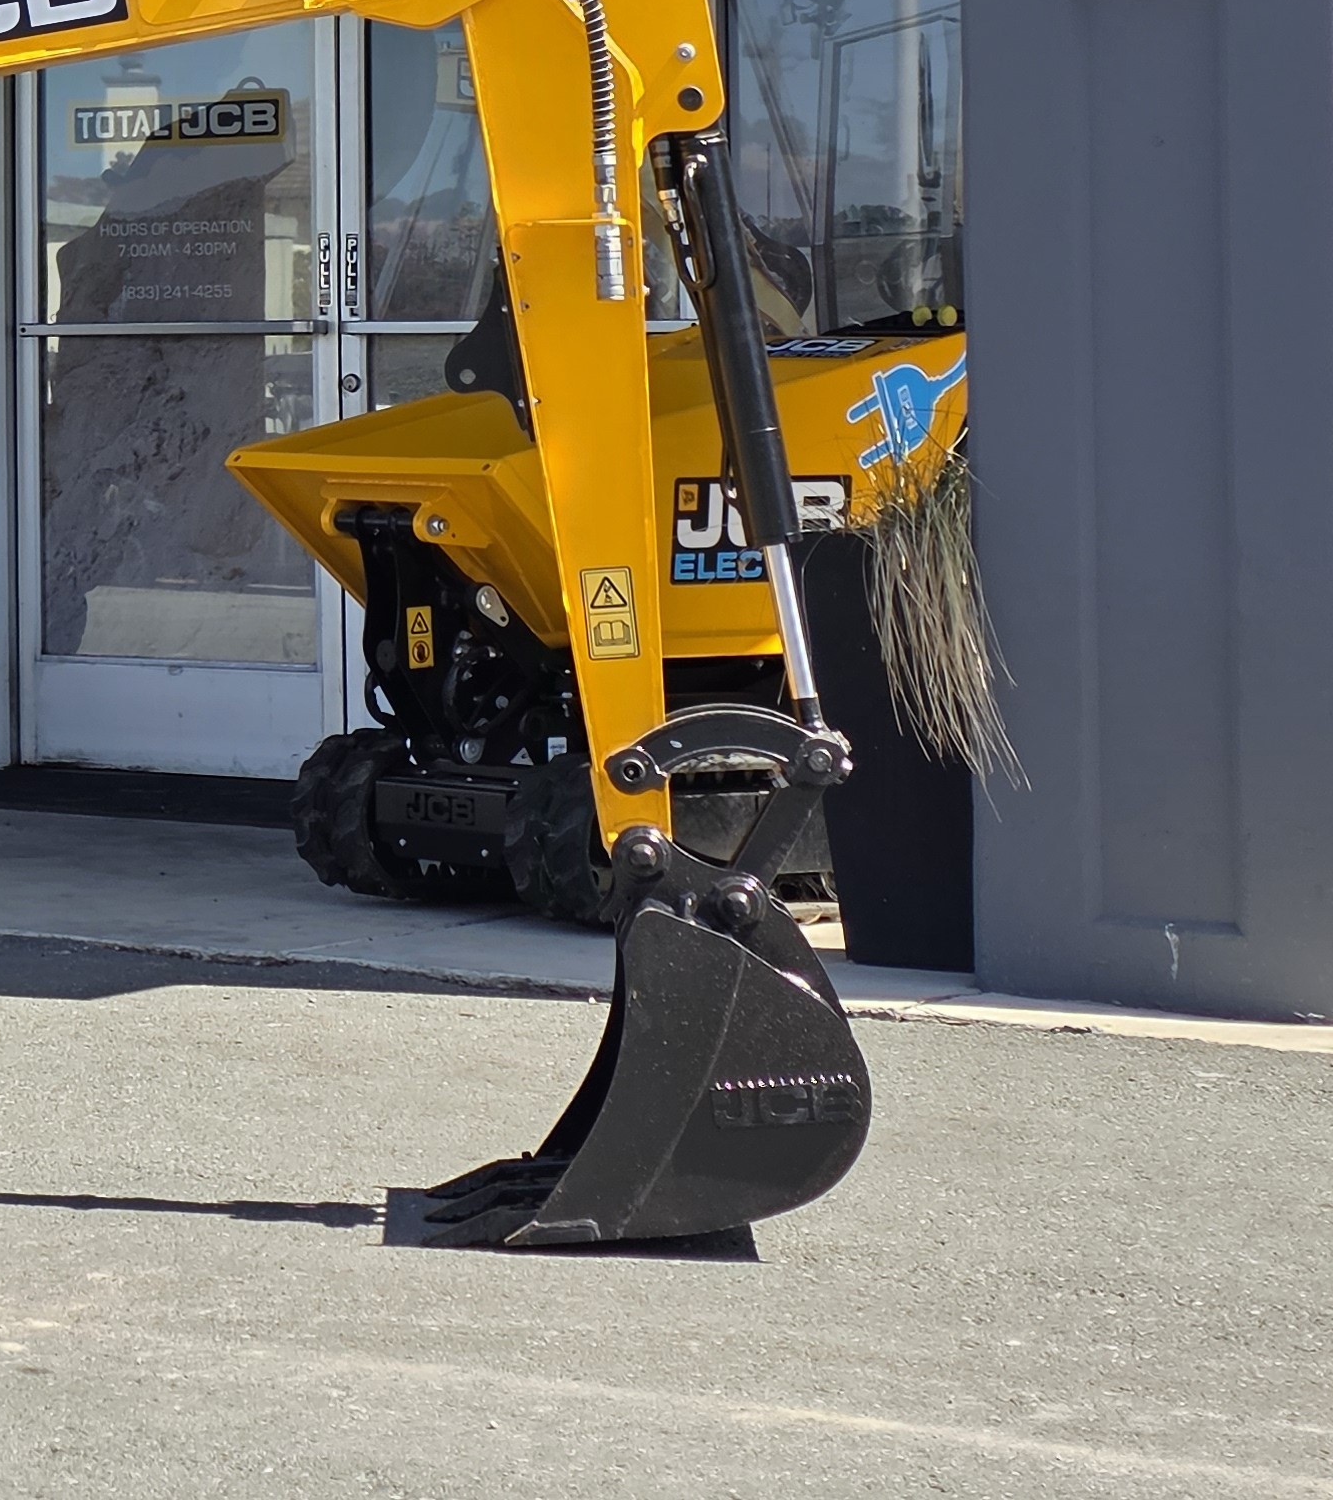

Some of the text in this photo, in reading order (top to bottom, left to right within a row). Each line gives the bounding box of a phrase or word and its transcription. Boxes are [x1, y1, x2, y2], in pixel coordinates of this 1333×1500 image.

[77, 102, 277, 139] TOTAL JCB
[100, 222, 148, 237] HOURS
[151, 222, 169, 236] OF
[118, 243, 172, 258] 7:00AM
[183, 242, 237, 257] 4:30PM
[319, 238, 330, 289] PULL
[346, 239, 358, 290] PULL
[163, 284, 233, 299] 241-4255
[766, 339, 876, 351] JCB
[406, 792, 475, 826] JCB
[714, 1083, 863, 1126] JCB
